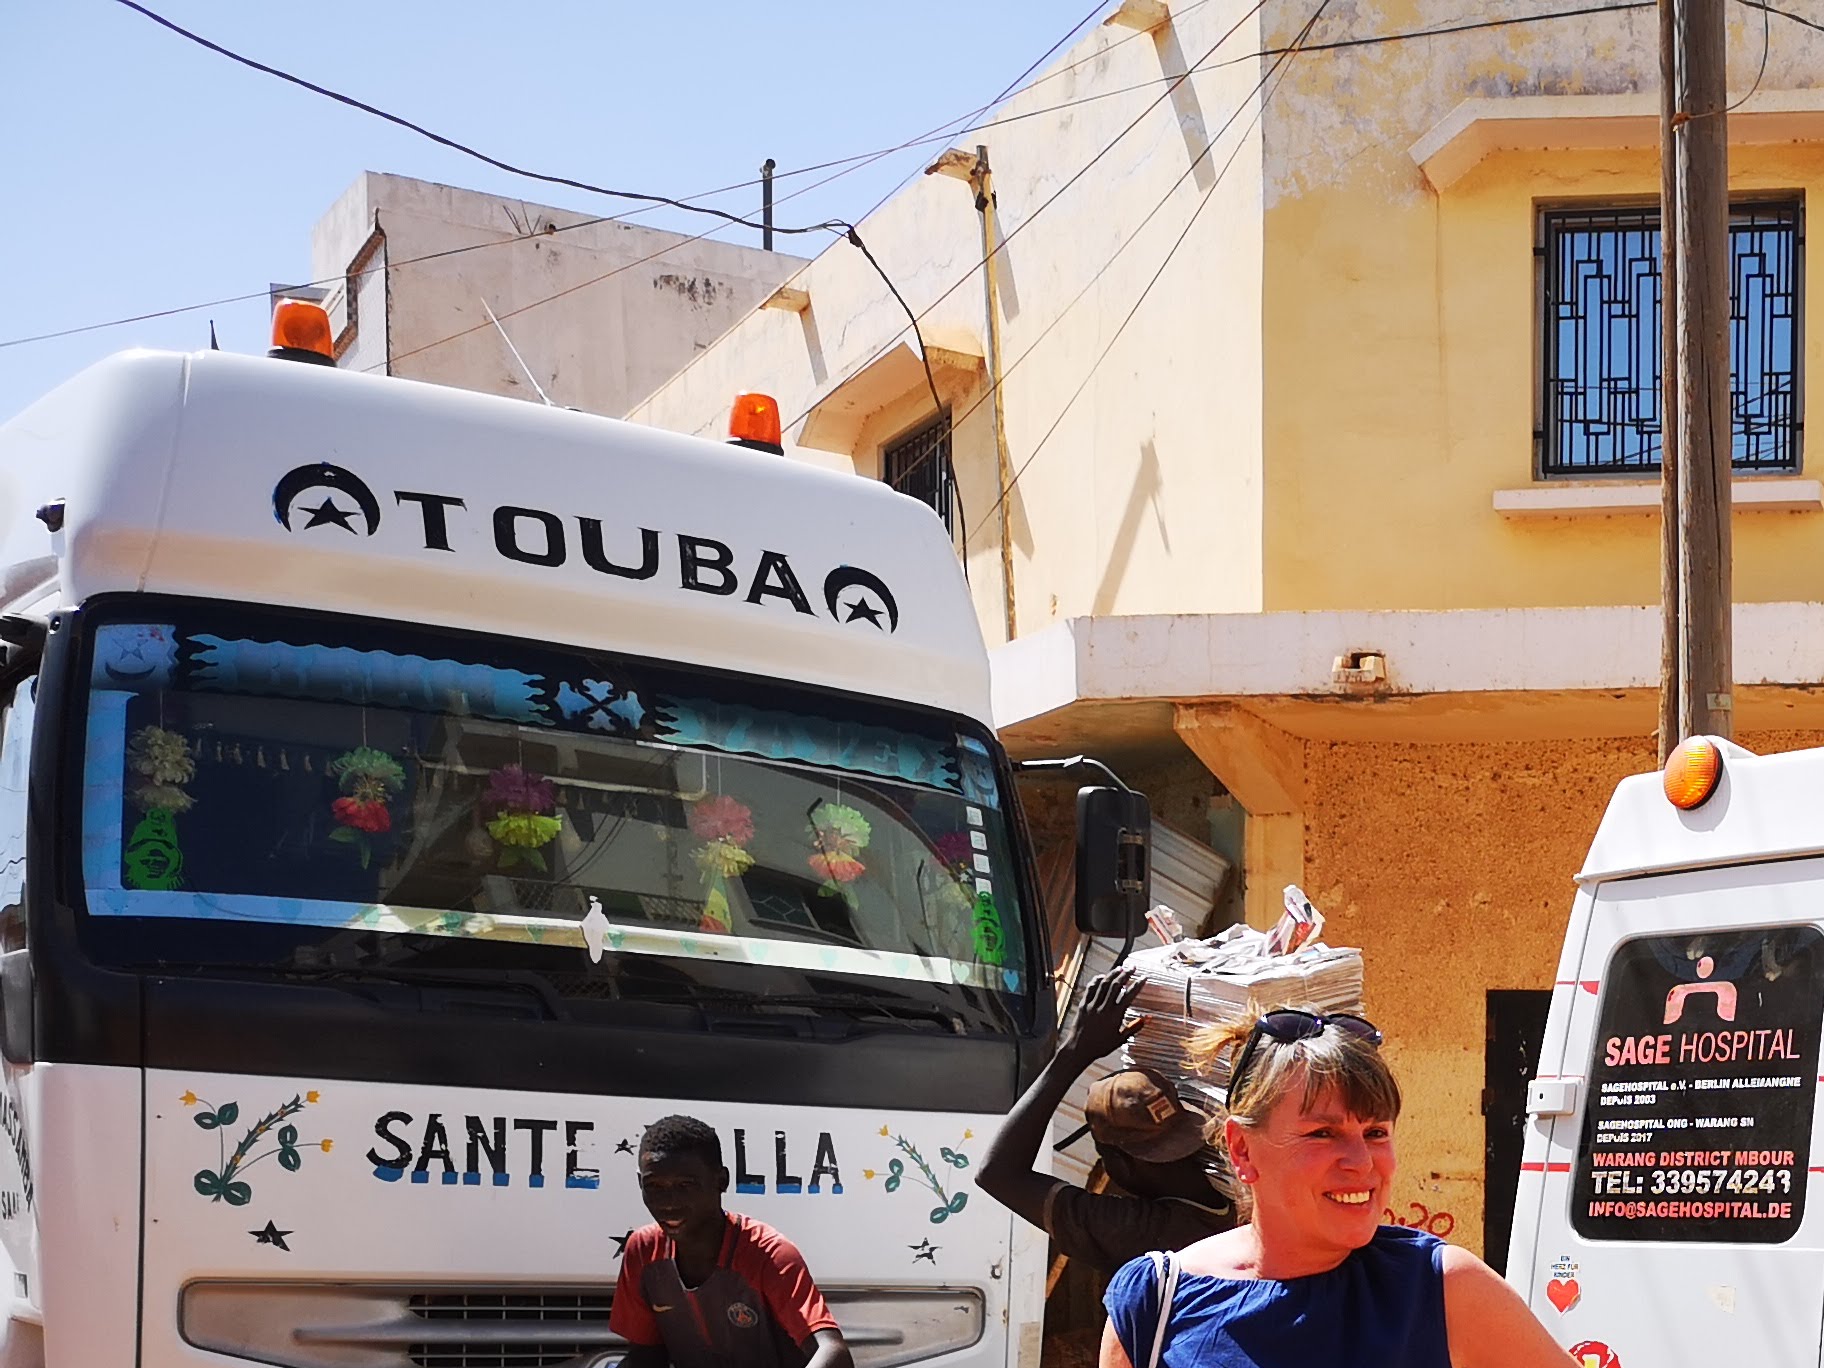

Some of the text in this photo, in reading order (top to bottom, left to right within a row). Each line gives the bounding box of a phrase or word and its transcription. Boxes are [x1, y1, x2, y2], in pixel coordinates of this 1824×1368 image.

[393, 490, 820, 617] TOUBA
[1604, 1029, 1801, 1067] SAGE HOSPITAL
[1601, 1081, 1669, 1093] SAGEHOSPITAL
[1695, 1079, 1731, 1089] BERLIN
[1634, 1094, 1656, 1104] 2003
[1597, 1119, 1665, 1130] SAGEHOSPITAL
[1667, 1119, 1688, 1129] ONG
[1695, 1118, 1738, 1128] WARANG
[1740, 1117, 1754, 1127] SN
[1631, 1132, 1653, 1142] 2017
[366, 1110, 600, 1189] SANTE
[1593, 1150, 1794, 1167] WARANG DISTRICT MBOUR
[1591, 1169, 1791, 1194] TEL: 339574243
[1588, 1202, 1792, 1219] INFO@SAGEHOSPITAL.DE
